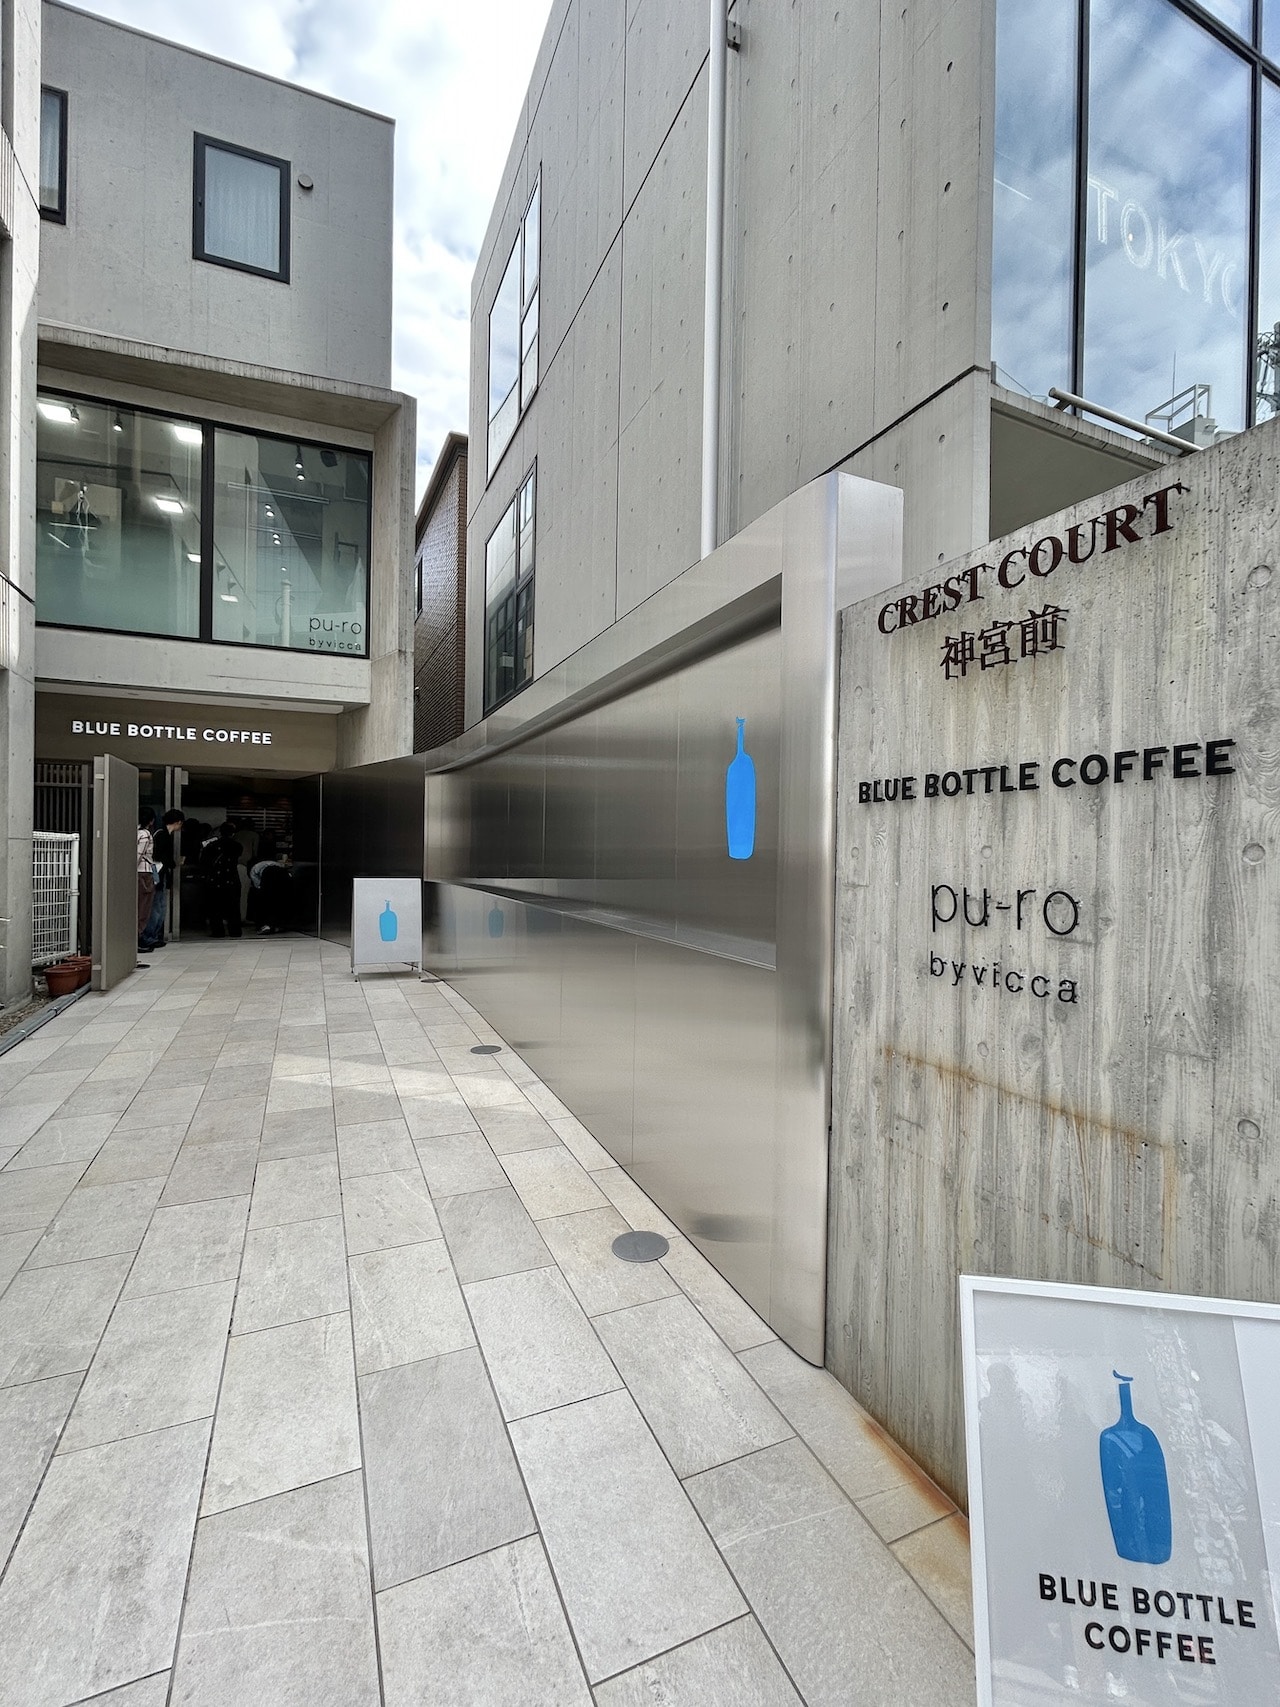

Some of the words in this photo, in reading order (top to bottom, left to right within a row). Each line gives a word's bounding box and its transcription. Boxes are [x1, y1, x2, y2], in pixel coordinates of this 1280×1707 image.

[877, 562, 994, 635] CREST
[998, 482, 1190, 589] COURT
[309, 617, 362, 635] pu-ro
[940, 604, 1069, 680] 神宮前
[72, 720, 121, 736] BLUE
[127, 723, 197, 740] BOTTLE
[202, 728, 272, 745] COFFEE
[858, 777, 917, 804] BLUE
[924, 761, 1040, 798] BOTTLE
[1051, 738, 1237, 788] COFFEE
[931, 884, 1080, 936] pu-ro
[1038, 1573, 1120, 1611] BLUE
[1132, 1586, 1257, 1629] BOTTLE
[1084, 1622, 1217, 1665] COFFEE
